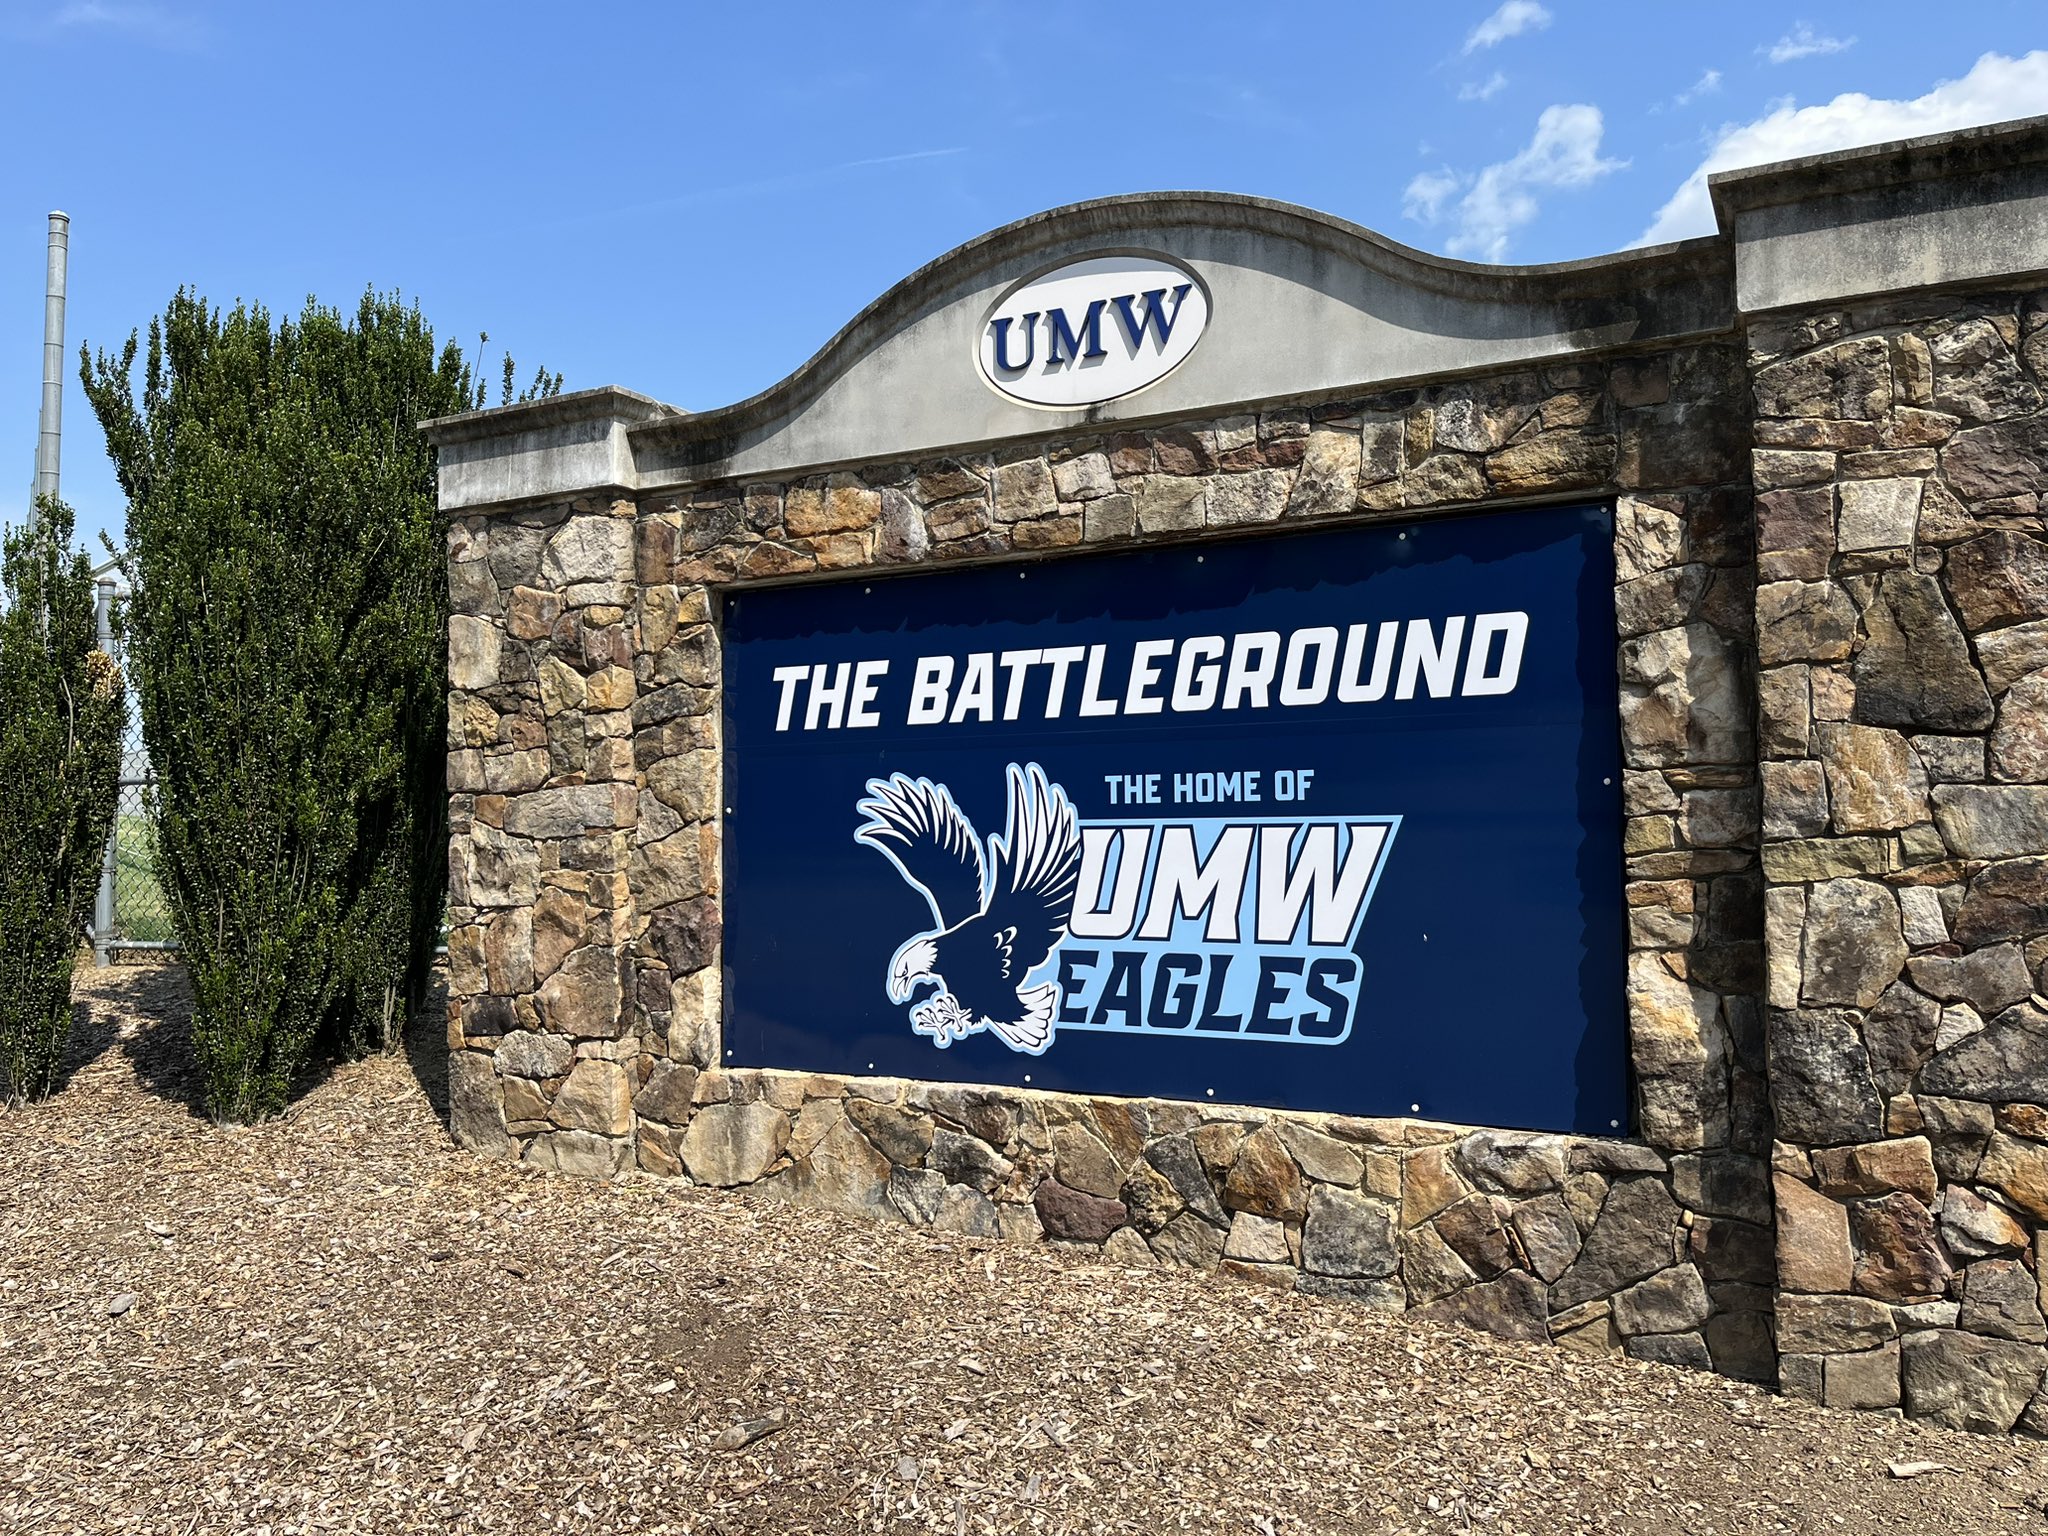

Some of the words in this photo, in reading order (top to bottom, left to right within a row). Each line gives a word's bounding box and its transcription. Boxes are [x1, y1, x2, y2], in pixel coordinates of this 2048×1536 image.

[990, 284, 1193, 372] UMW
[772, 659, 889, 732] THE
[906, 611, 1529, 726] BATTLEGROUND
[1104, 774, 1162, 805] THE
[1173, 771, 1261, 803] HOME
[1275, 769, 1315, 801] OF
[1068, 822, 1392, 944] UMW
[1057, 949, 1358, 1037] EAGLES
